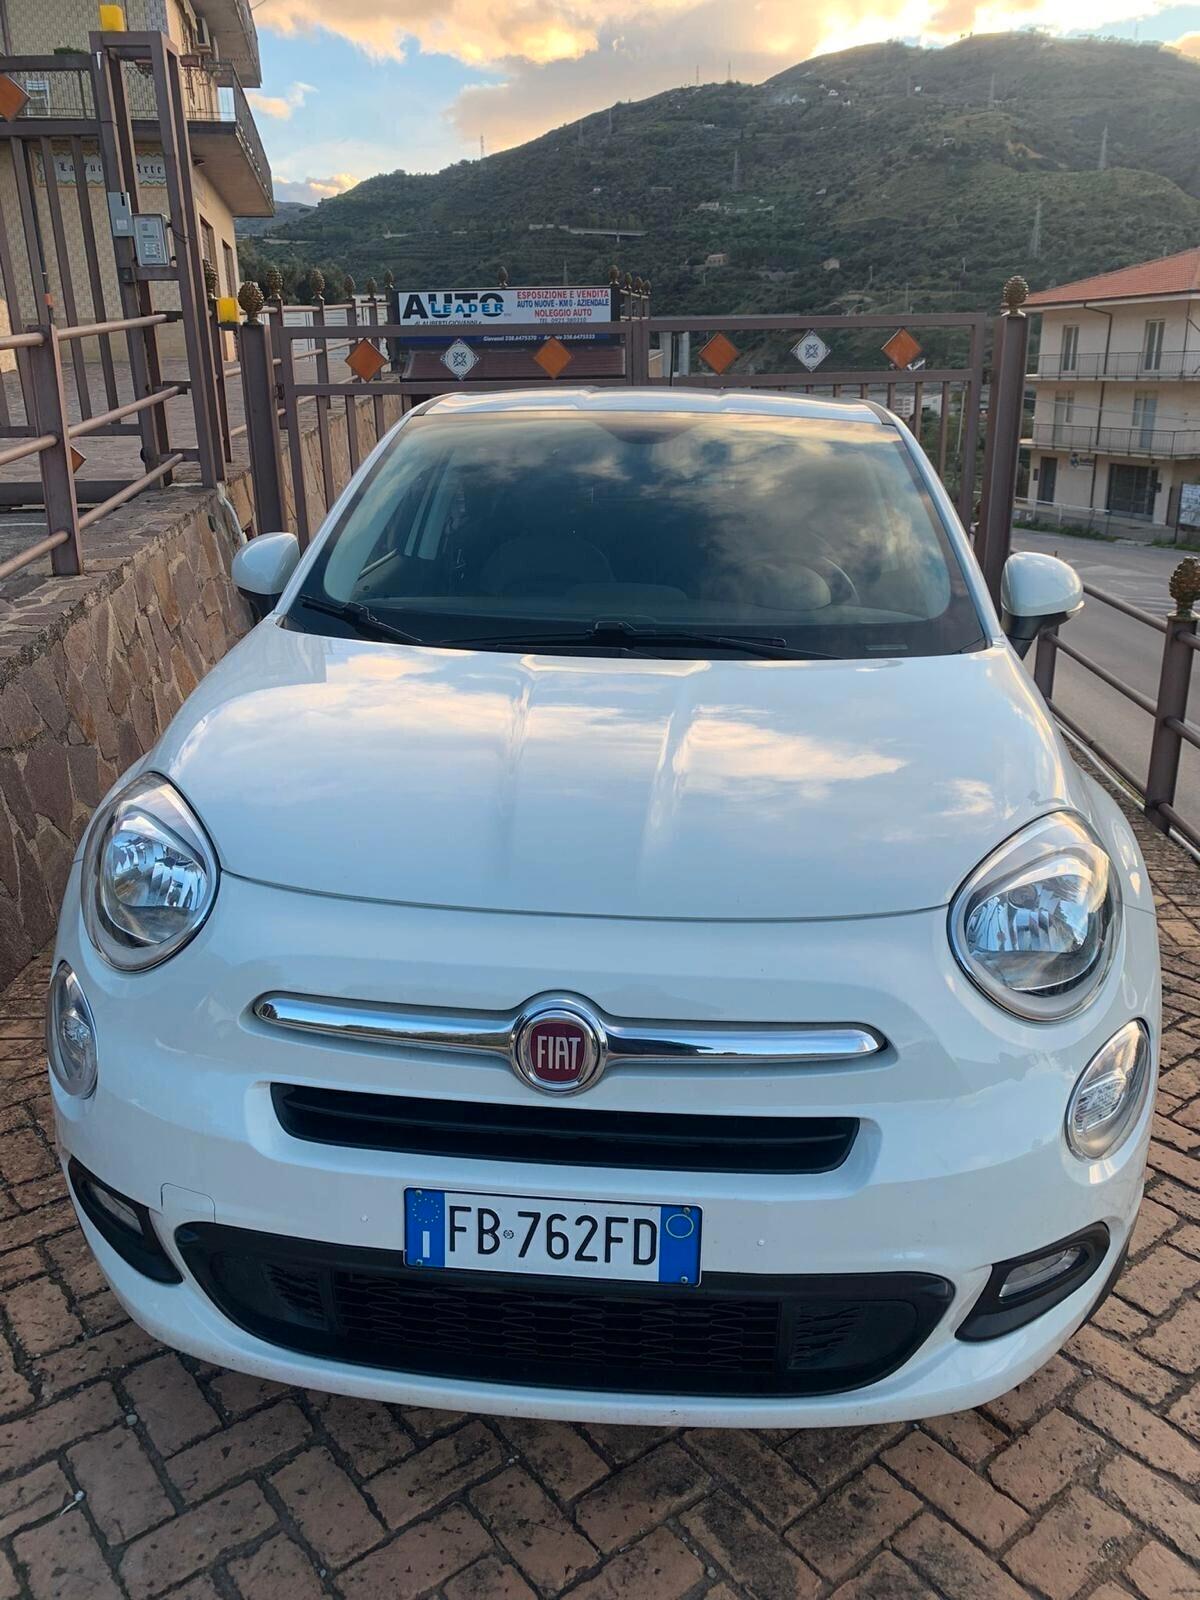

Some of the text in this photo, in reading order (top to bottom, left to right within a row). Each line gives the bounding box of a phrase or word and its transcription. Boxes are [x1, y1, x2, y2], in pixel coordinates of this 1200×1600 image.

[517, 289, 609, 300] ESPOSIZIONE E VENDITA
[402, 292, 504, 319] AUTO
[430, 301, 504, 313] LEADER
[517, 300, 533, 308] AUTO
[534, 299, 555, 308] NUOVE
[577, 298, 609, 307] AZIENDALE
[534, 308, 592, 318] NOLEGGIO AUTO
[537, 1035, 581, 1070] FIAT
